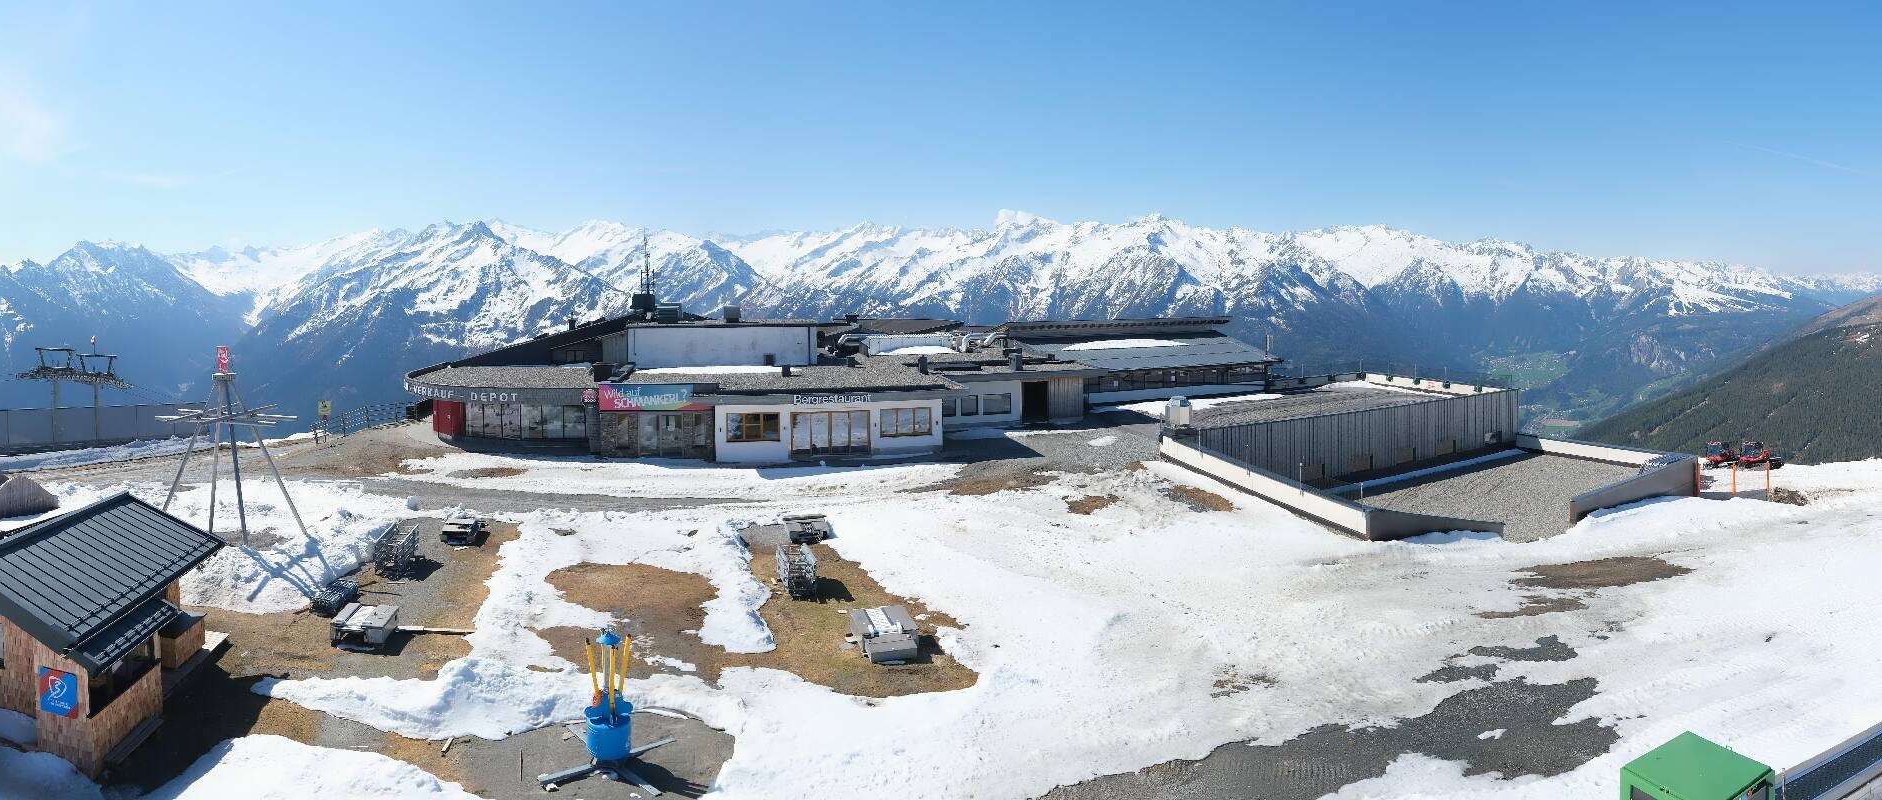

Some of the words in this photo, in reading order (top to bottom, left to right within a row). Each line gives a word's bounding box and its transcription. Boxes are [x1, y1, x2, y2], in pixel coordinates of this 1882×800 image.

[414, 386, 455, 400] VERKAUF
[470, 391, 518, 402] DEPOT
[605, 388, 624, 400] Wild
[626, 386, 642, 398] auf
[793, 394, 872, 405] Bergrestaurant
